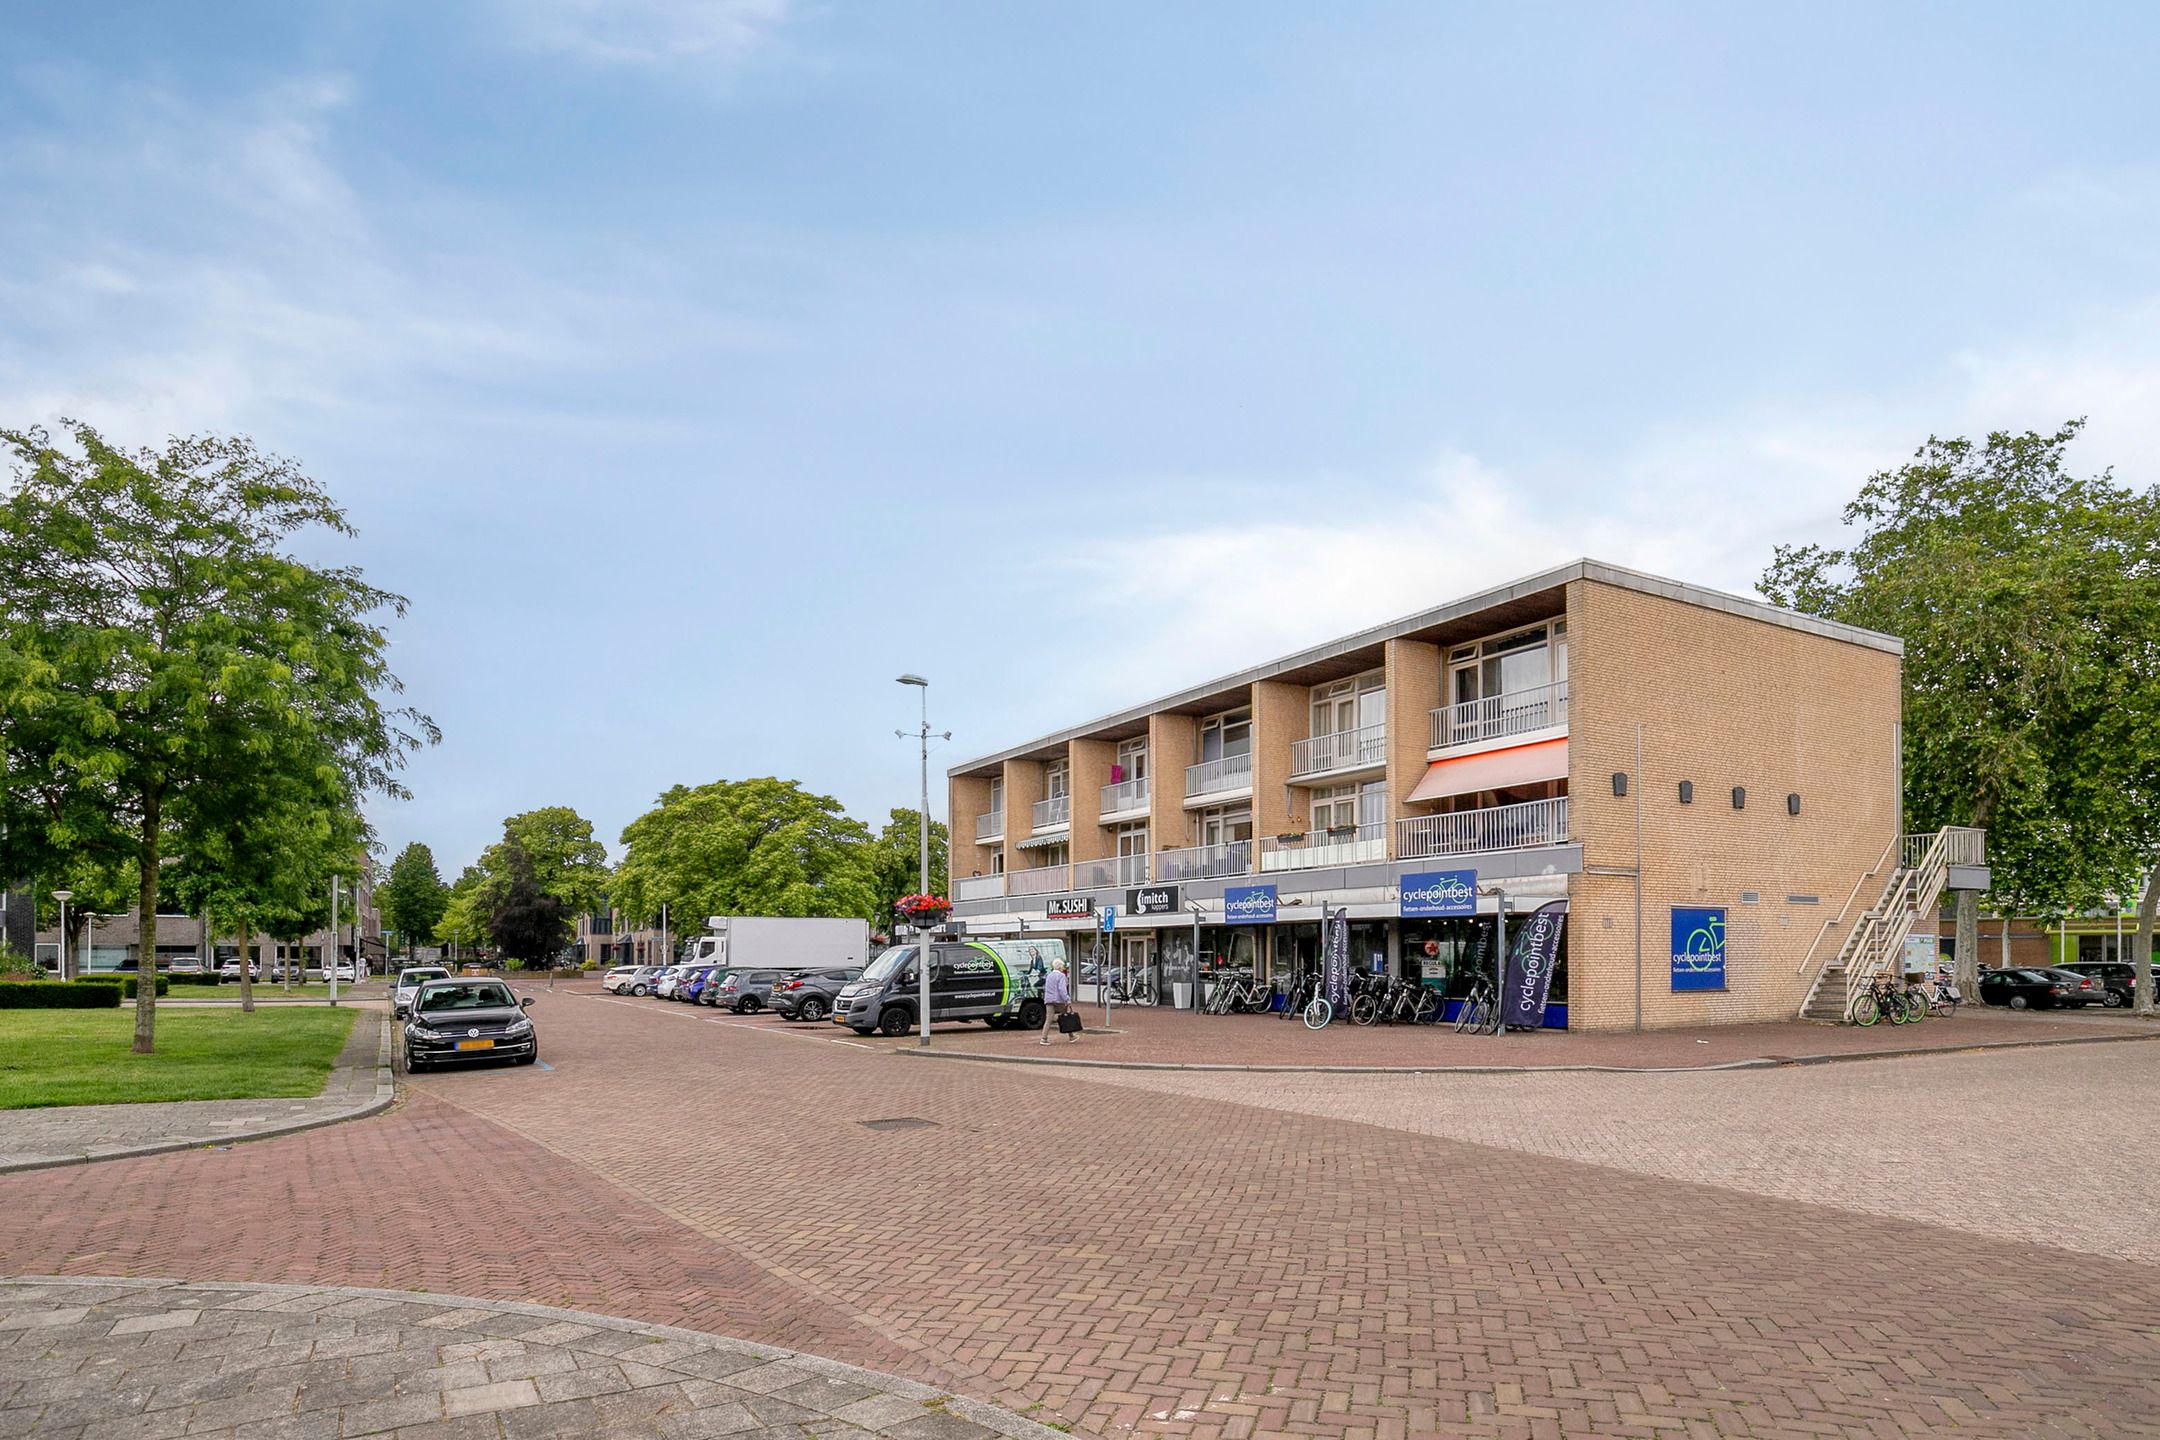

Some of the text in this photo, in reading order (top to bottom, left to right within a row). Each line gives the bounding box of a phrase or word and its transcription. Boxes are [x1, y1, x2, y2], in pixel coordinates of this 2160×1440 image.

[1403, 887, 1473, 903] cyclepointbest
[1049, 898, 1088, 914] Mr. SUSHI
[1226, 898, 1274, 912] cyclepointbest
[1106, 908, 1113, 918] P
[1520, 912, 1549, 1011] cyclepointbest
[1673, 952, 1722, 964] cyclepointbest
